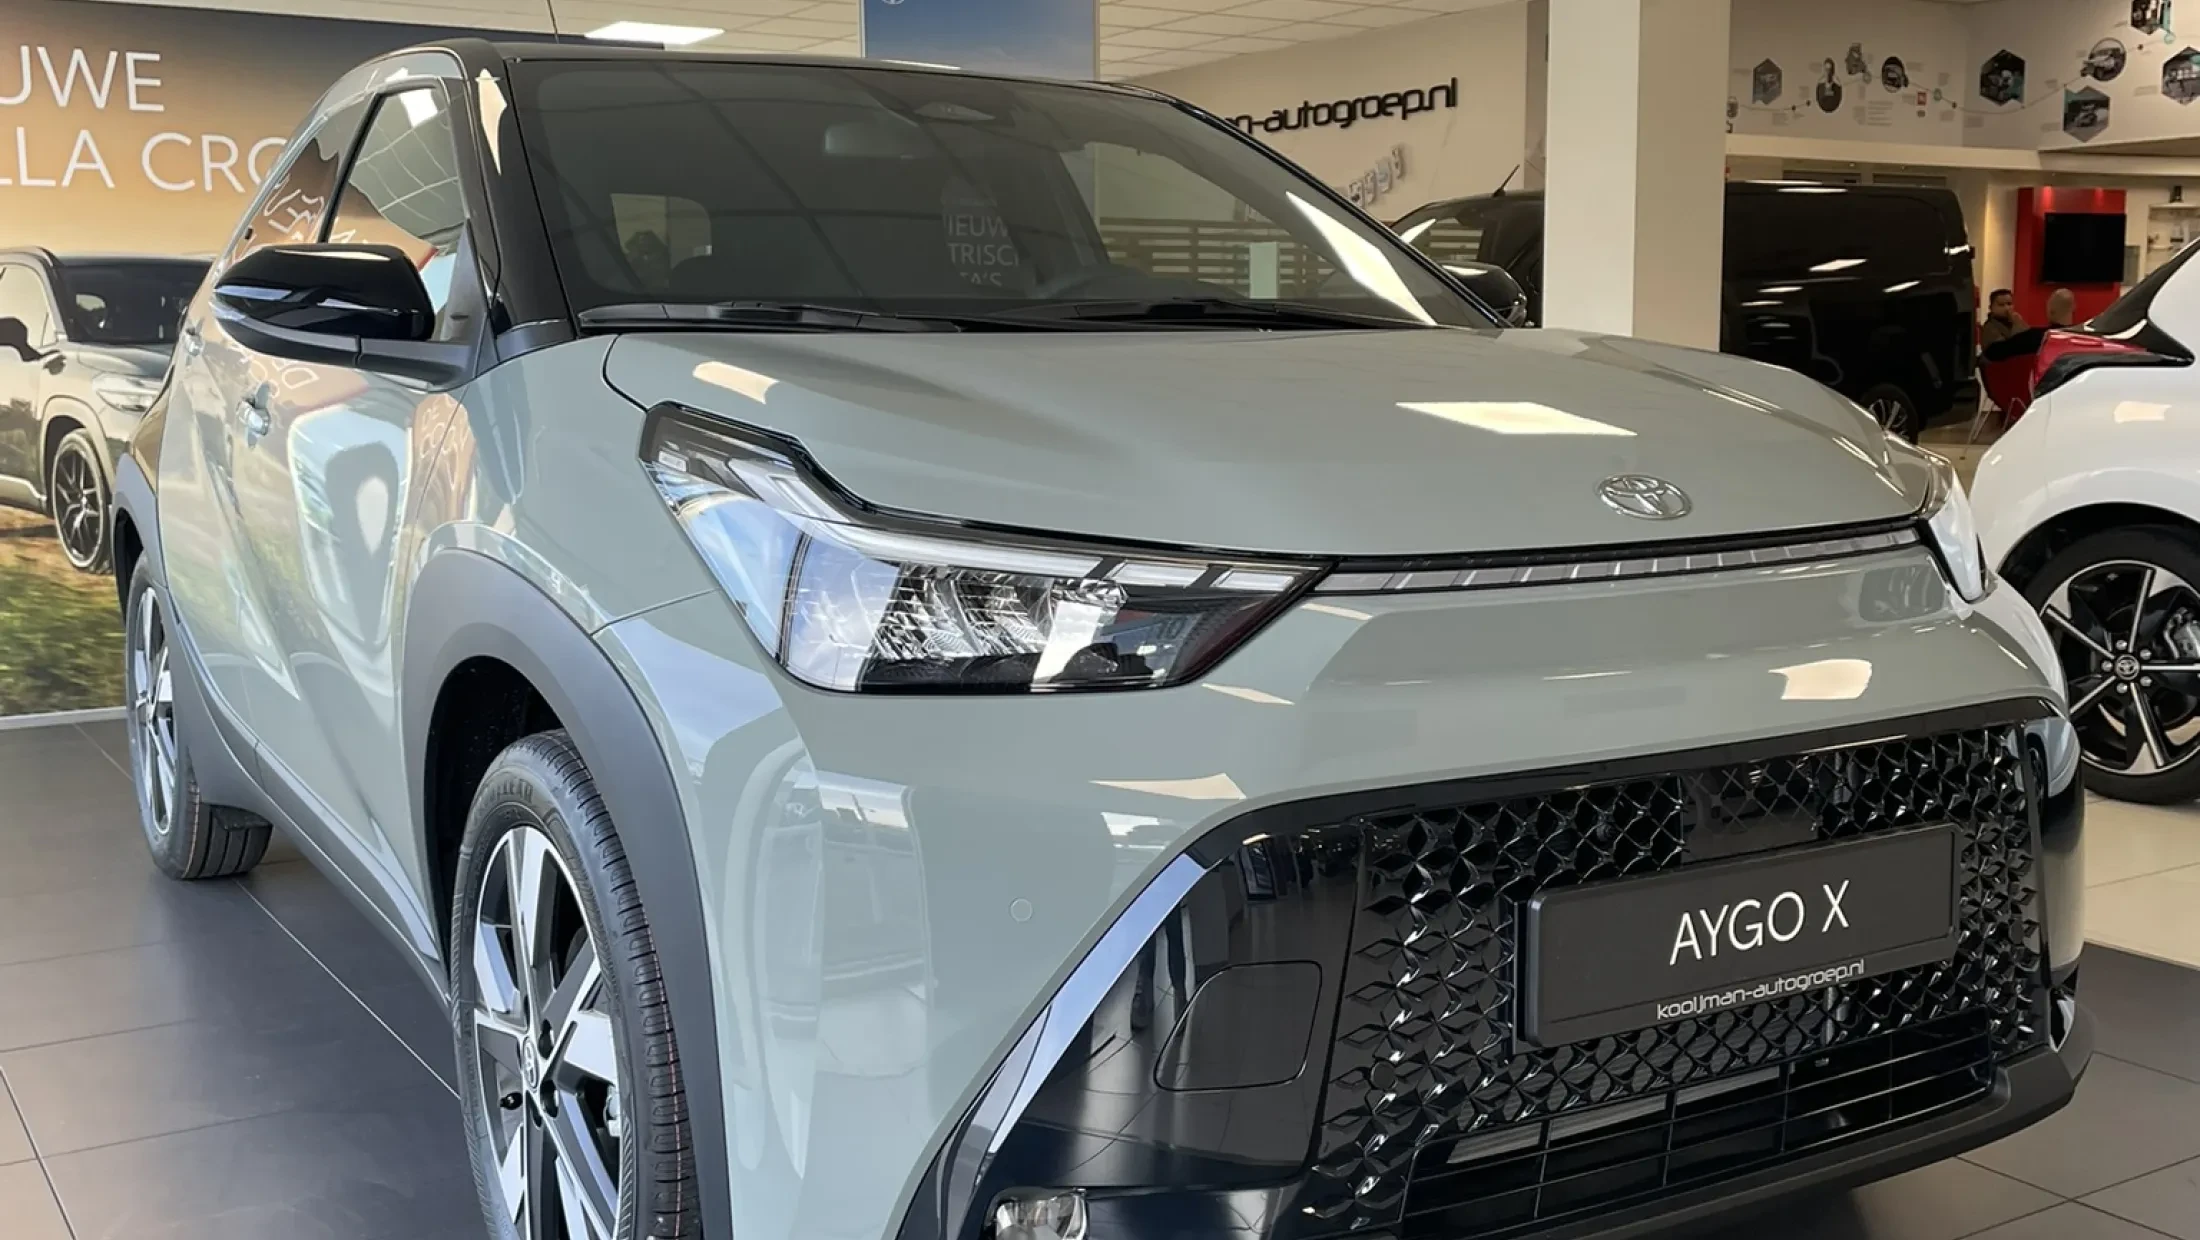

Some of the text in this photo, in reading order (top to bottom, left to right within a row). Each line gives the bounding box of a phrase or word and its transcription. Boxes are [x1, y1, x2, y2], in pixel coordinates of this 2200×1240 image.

[1669, 879, 1850, 966] AYGO X
[1656, 958, 1865, 1021] kooijman-autogroep.nl
